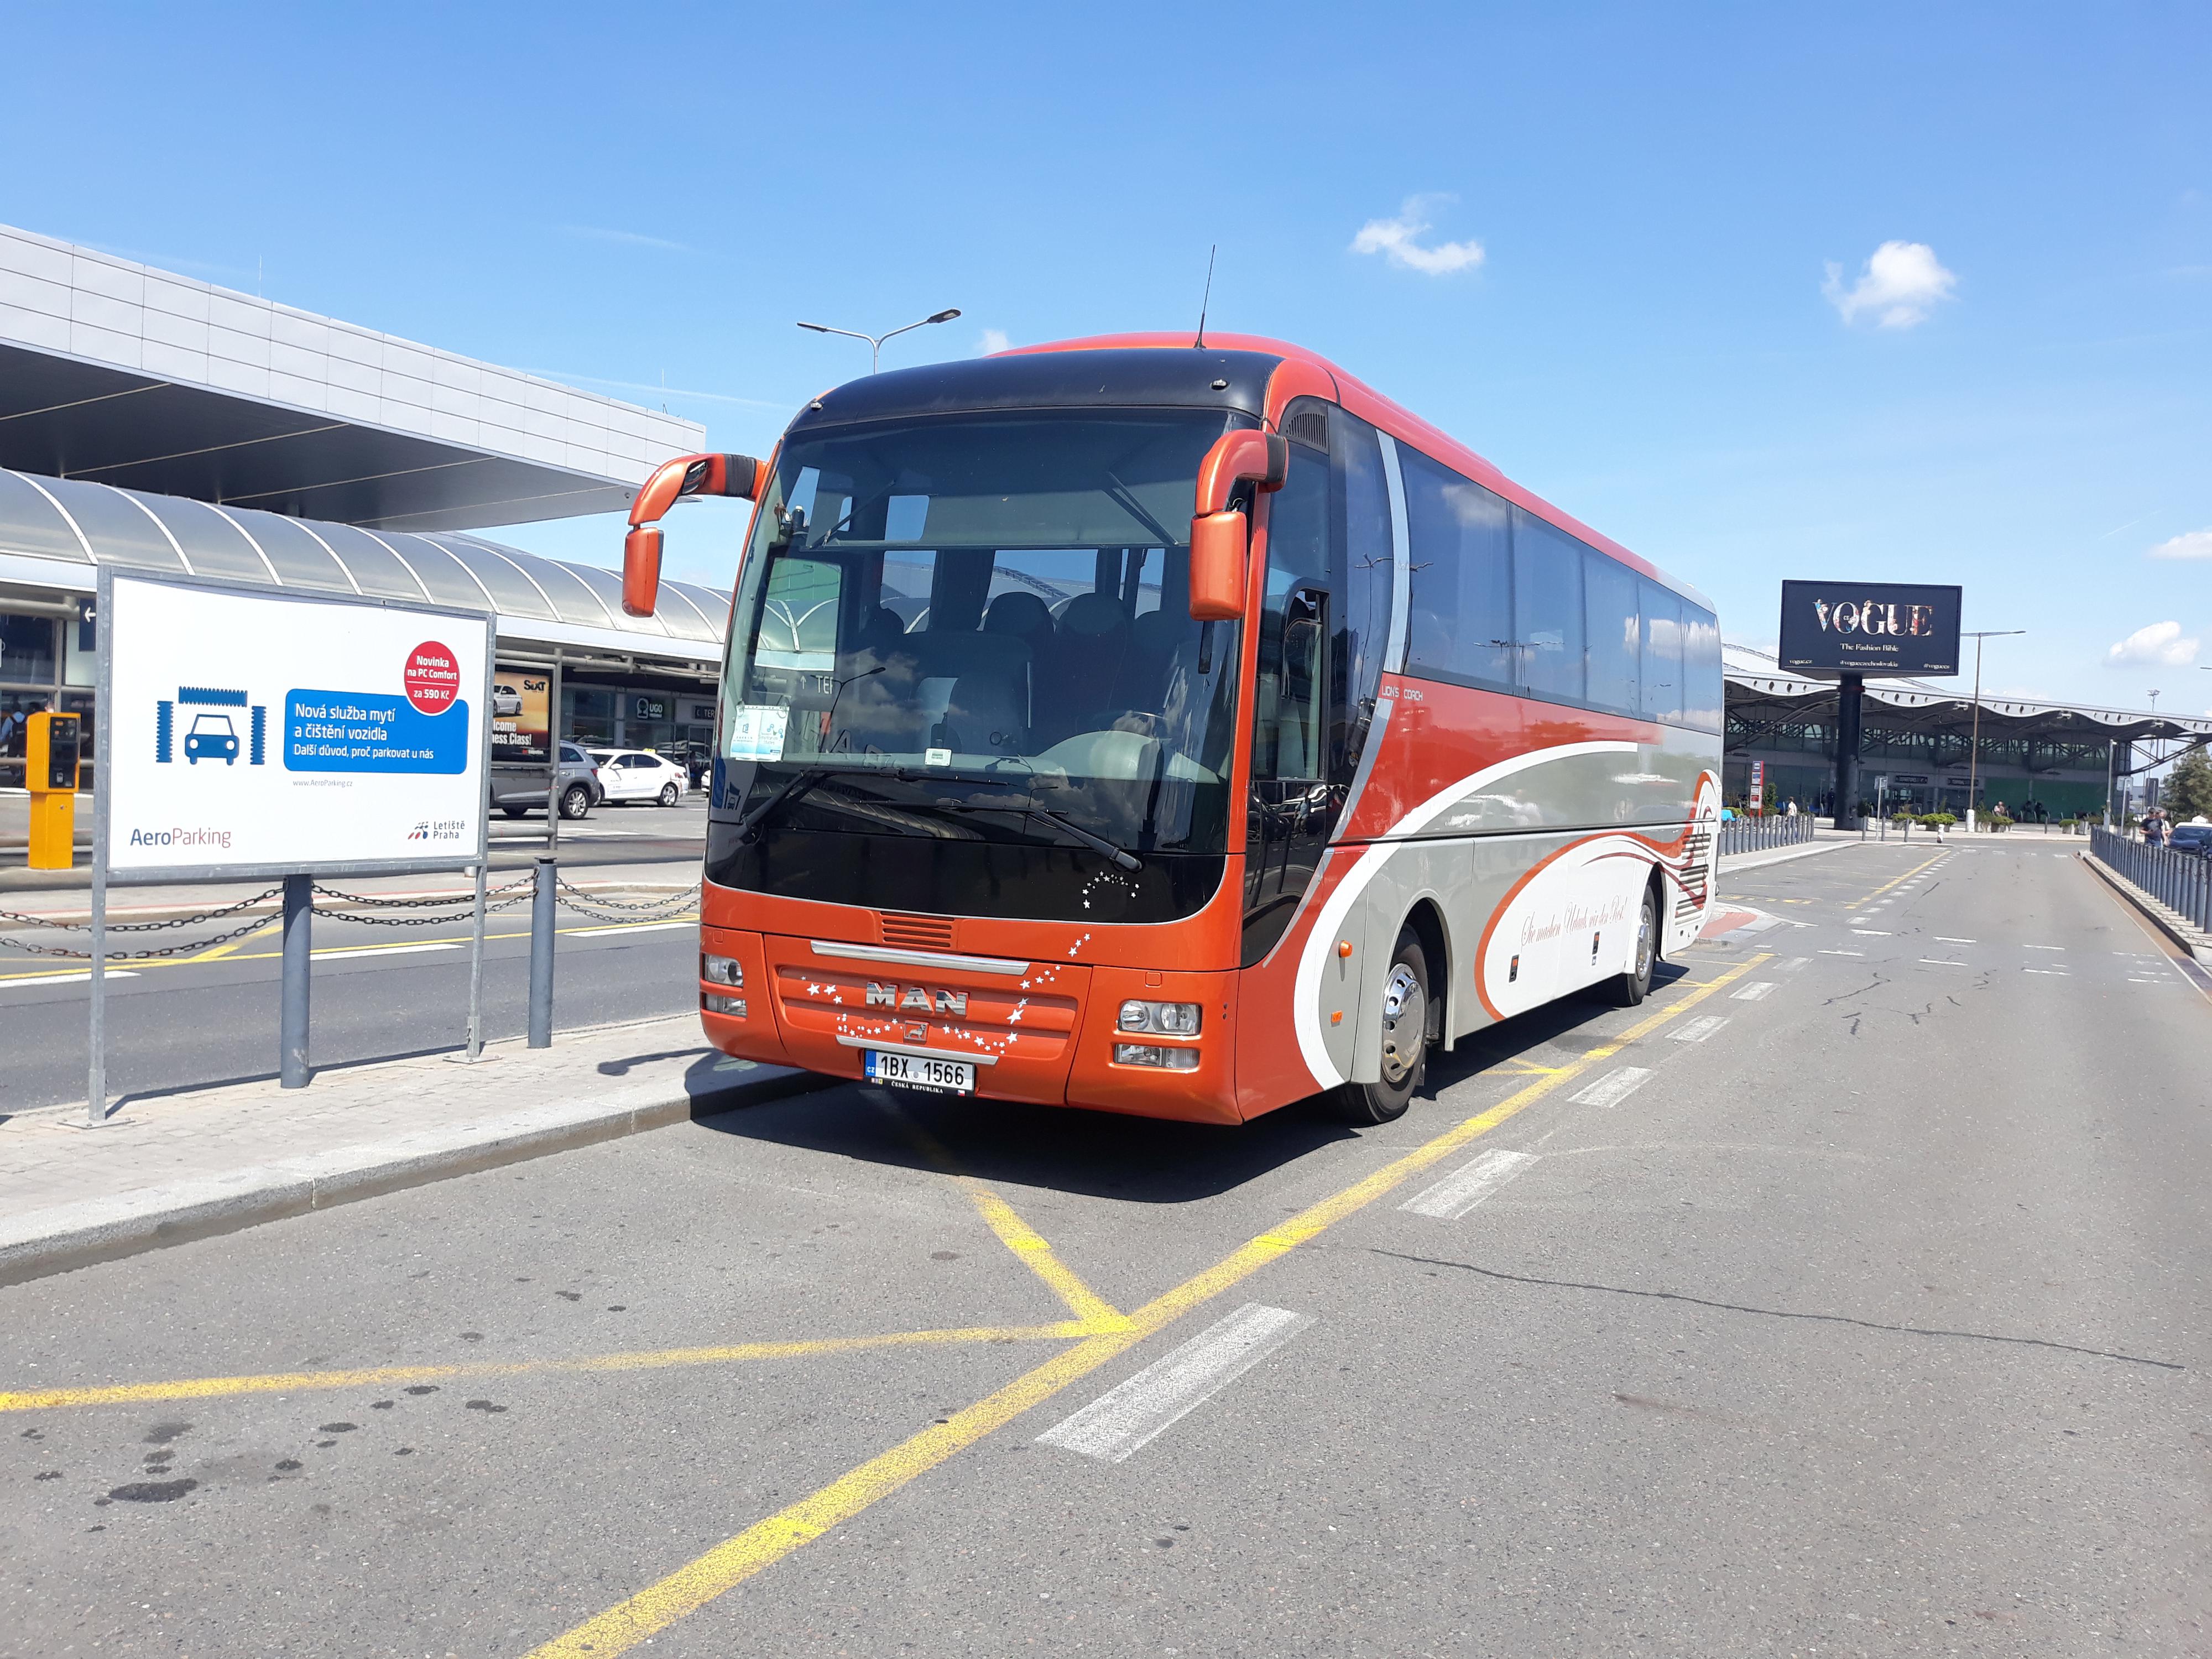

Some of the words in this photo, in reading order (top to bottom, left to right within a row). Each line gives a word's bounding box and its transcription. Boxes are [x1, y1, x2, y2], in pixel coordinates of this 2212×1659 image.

[1812, 599, 1933, 636] VOGUE
[416, 655, 449, 667] Novinka
[418, 668, 427, 677] PC
[429, 669, 457, 680] Comfort
[414, 690, 422, 698] za
[424, 689, 439, 699] 590
[441, 690, 450, 700] Kč
[1381, 685, 1400, 698] LION'S
[1404, 688, 1423, 701] COACH
[295, 703, 327, 718] Nová
[330, 705, 367, 721] služba
[369, 708, 396, 724] mytí
[649, 703, 663, 713] UGO
[294, 726, 302, 738] a
[305, 723, 346, 739] čištění
[348, 726, 387, 741] vozidla
[509, 733, 532, 746] Class!
[294, 744, 317, 756] Další
[319, 744, 349, 758] důvod,
[351, 746, 371, 759] proč
[373, 747, 410, 759] parkovat
[411, 750, 418, 758] u
[419, 748, 434, 759] nás
[293, 779, 353, 787] www.AeroParking.cz
[434, 820, 465, 830] Letiště
[130, 827, 231, 848] AeroParking
[434, 830, 459, 839] Praha
[866, 982, 968, 1015] MAN
[881, 1055, 909, 1079] 1BX
[924, 1062, 964, 1086] 1566
[891, 1081, 909, 1089] ČESKÁ
[912, 1084, 943, 1094] REPUBLIKA
